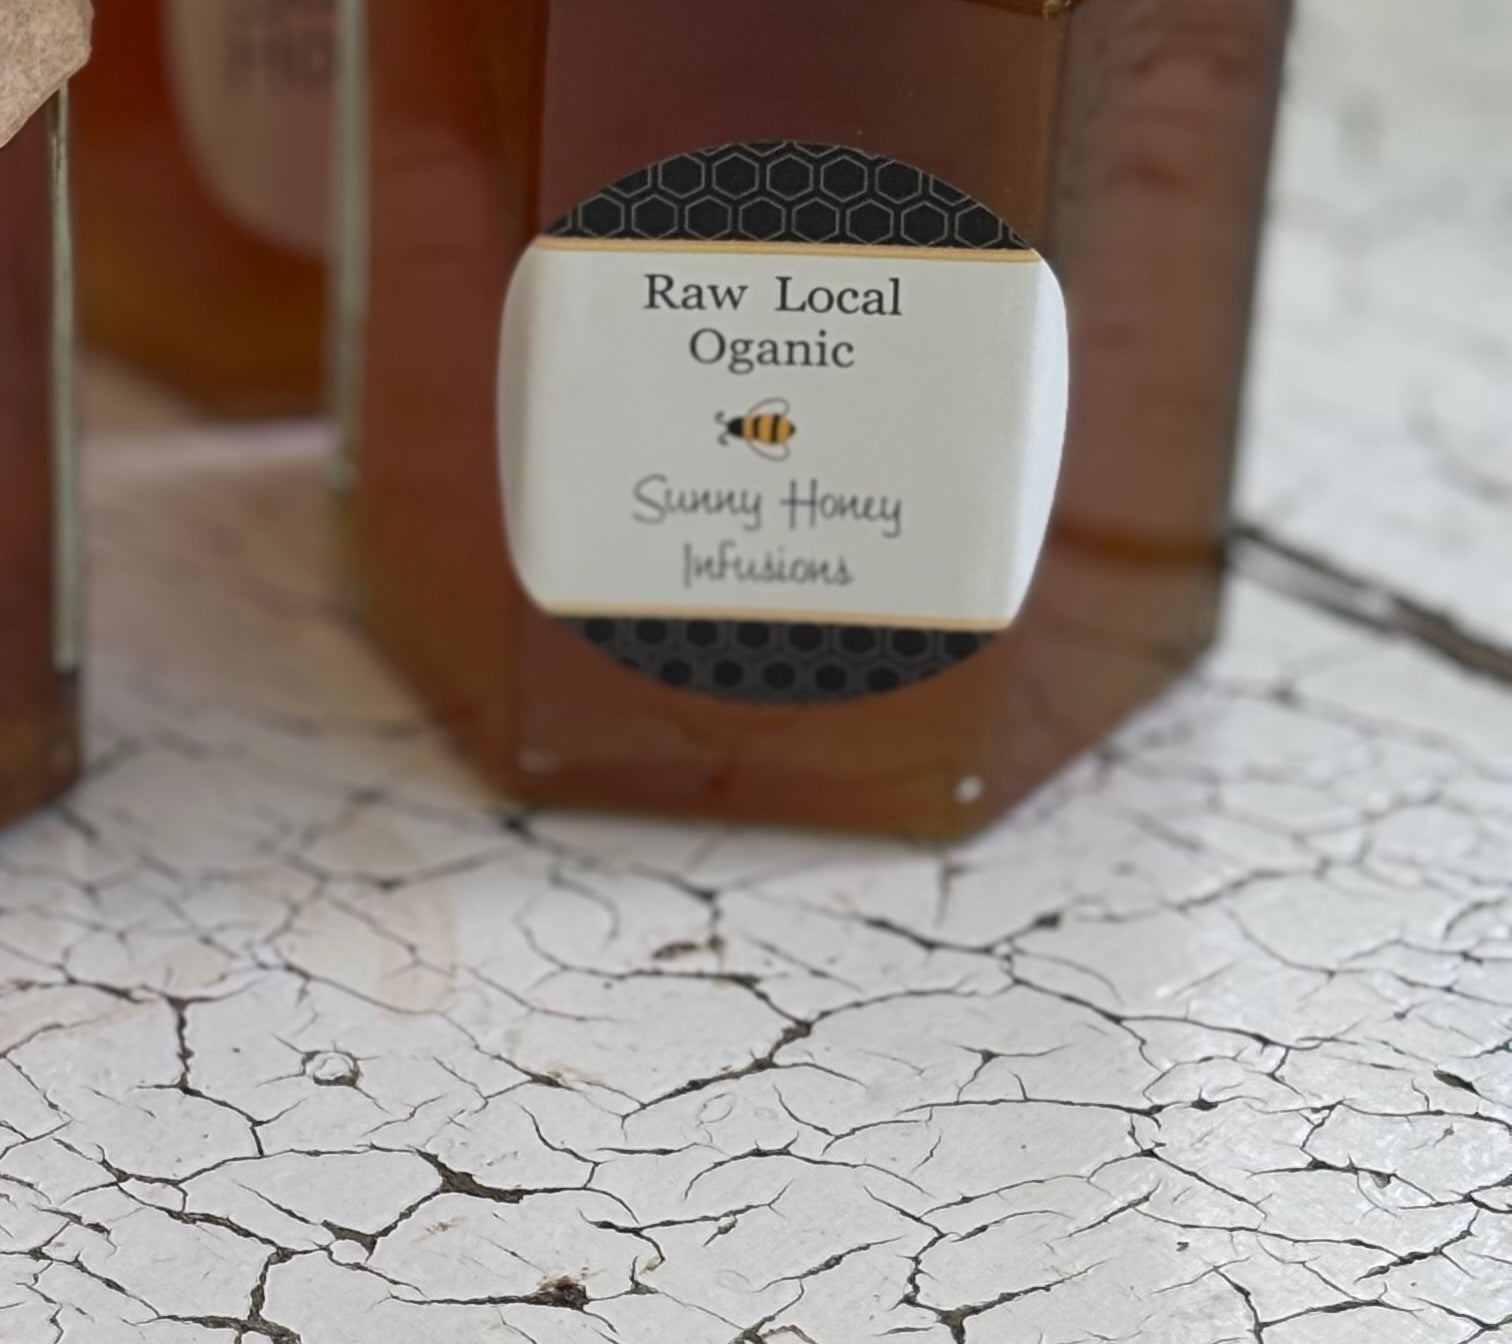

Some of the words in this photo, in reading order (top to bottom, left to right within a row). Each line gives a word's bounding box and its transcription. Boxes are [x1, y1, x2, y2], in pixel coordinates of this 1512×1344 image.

[642, 272, 750, 312] Raw
[774, 275, 904, 317] Local
[688, 327, 857, 376] Oganic
[630, 473, 763, 532] Sunny
[778, 477, 904, 538] Honey
[682, 541, 857, 591] Infusions
